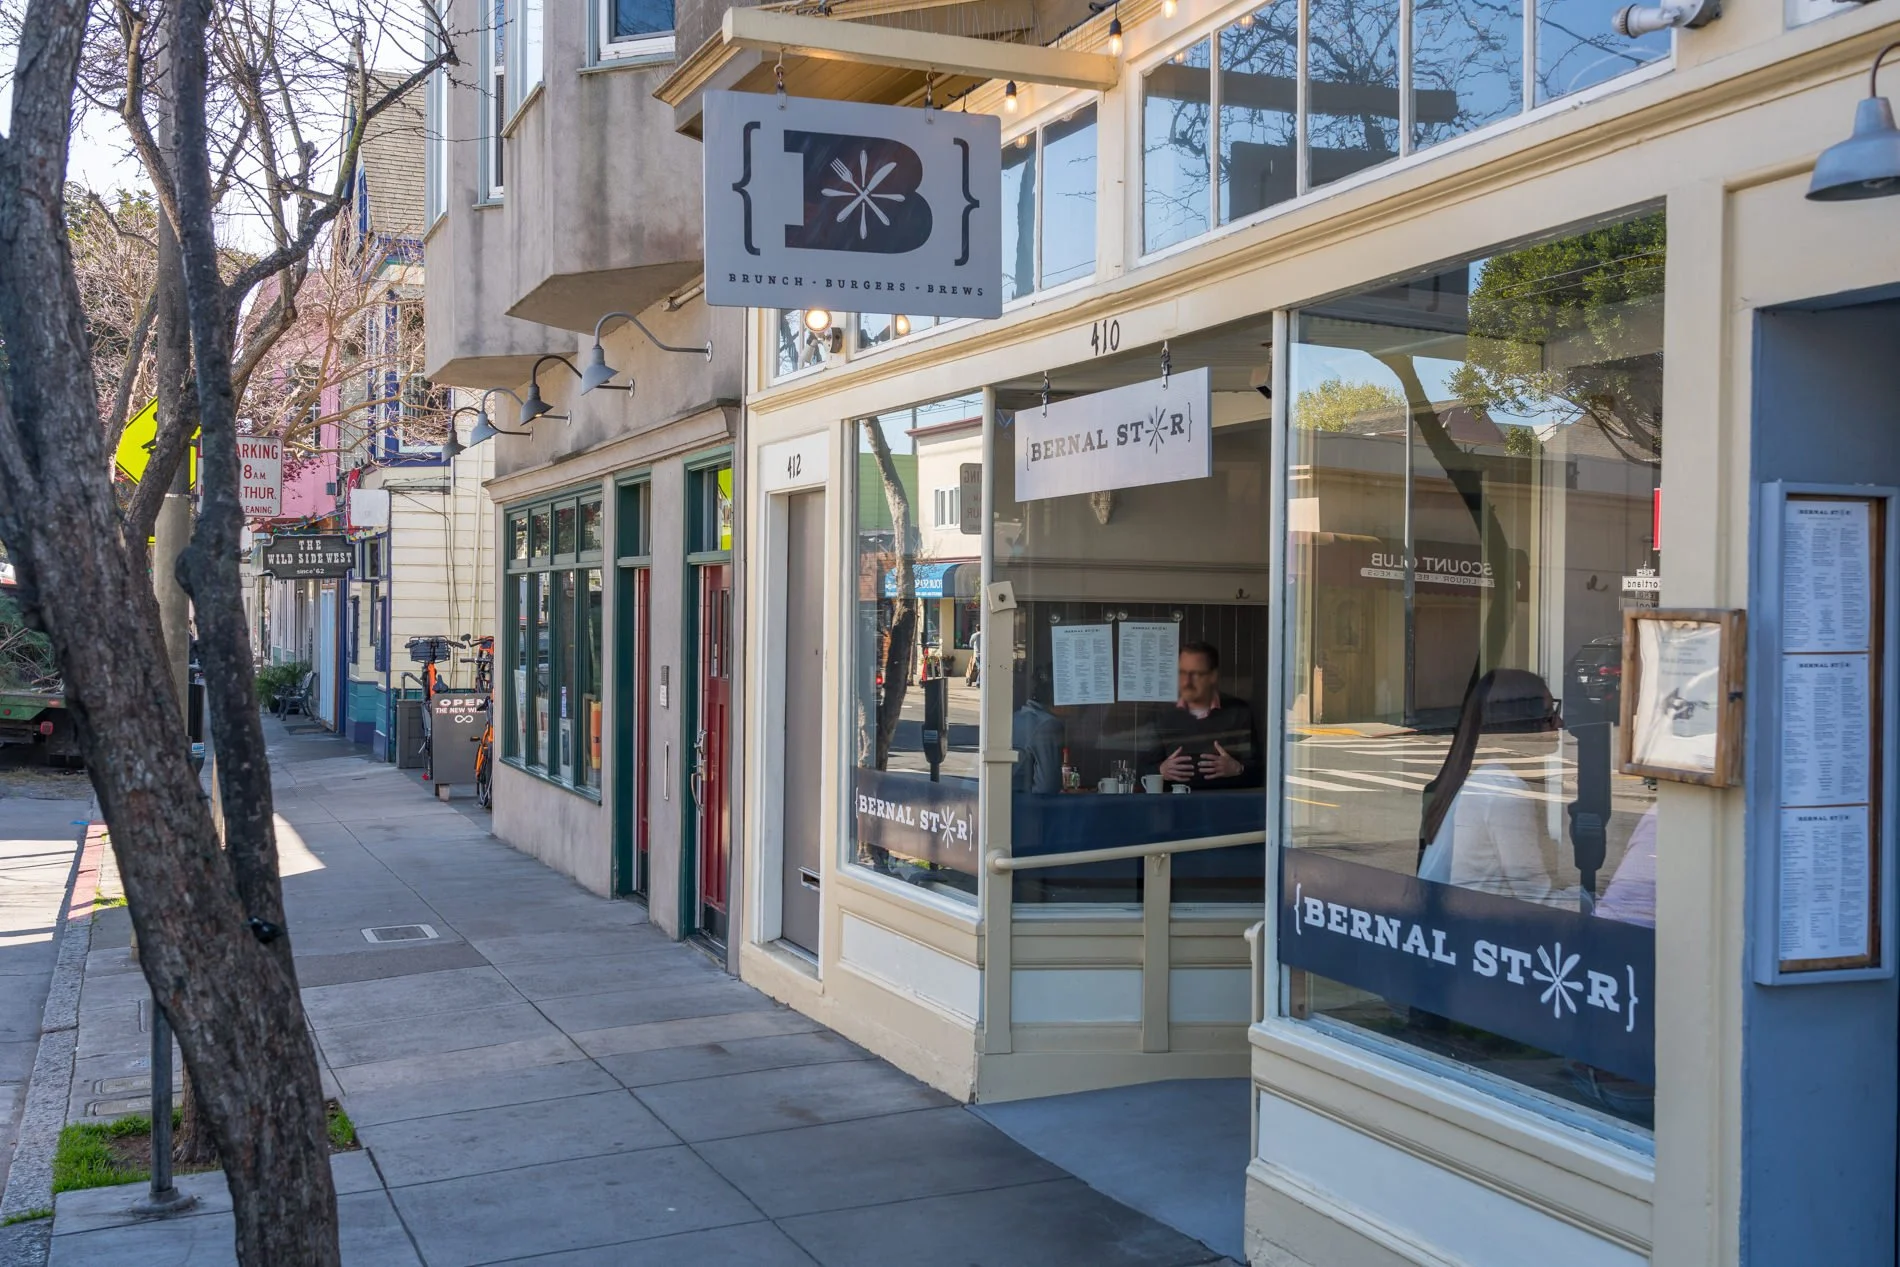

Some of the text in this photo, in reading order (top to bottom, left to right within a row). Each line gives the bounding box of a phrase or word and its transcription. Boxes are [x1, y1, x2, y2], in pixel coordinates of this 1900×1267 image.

[728, 273, 984, 297] BRUNCH BURGERS BREWS
[1091, 320, 1120, 356] 410
[236, 444, 279, 460] ARKING
[787, 453, 802, 480] 412
[299, 540, 322, 551] THE
[267, 552, 352, 565] WILD SIDE WEST
